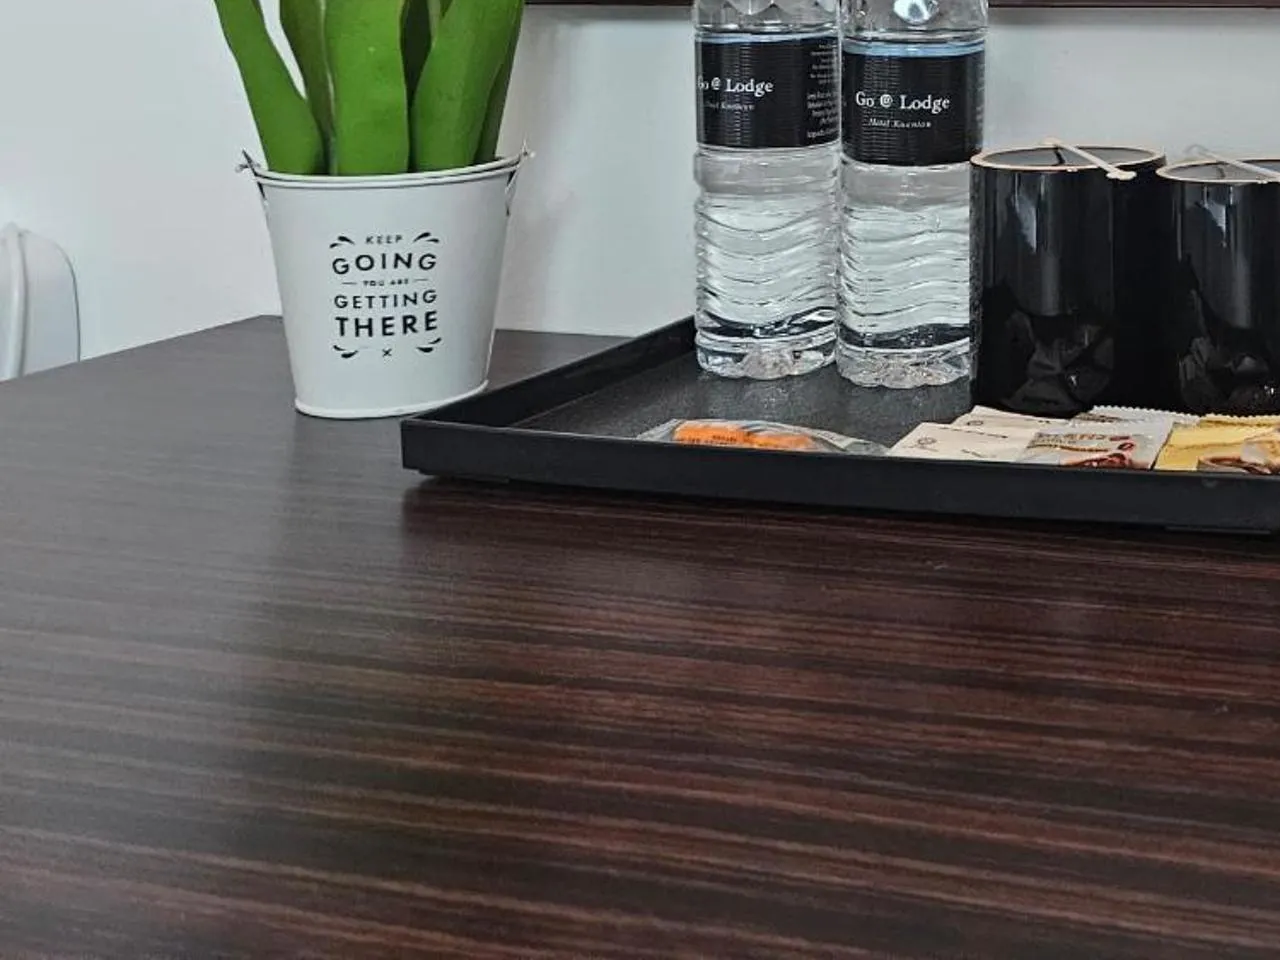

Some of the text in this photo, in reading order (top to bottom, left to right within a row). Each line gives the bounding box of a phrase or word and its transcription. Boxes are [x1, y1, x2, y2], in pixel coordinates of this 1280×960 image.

[725, 78, 774, 97] Lodge
[856, 91, 950, 114] Go @ Lodge
[366, 235, 402, 244] KEEP
[332, 253, 437, 274] GOING
[334, 289, 437, 309] GETTING
[335, 310, 438, 337] THERE
